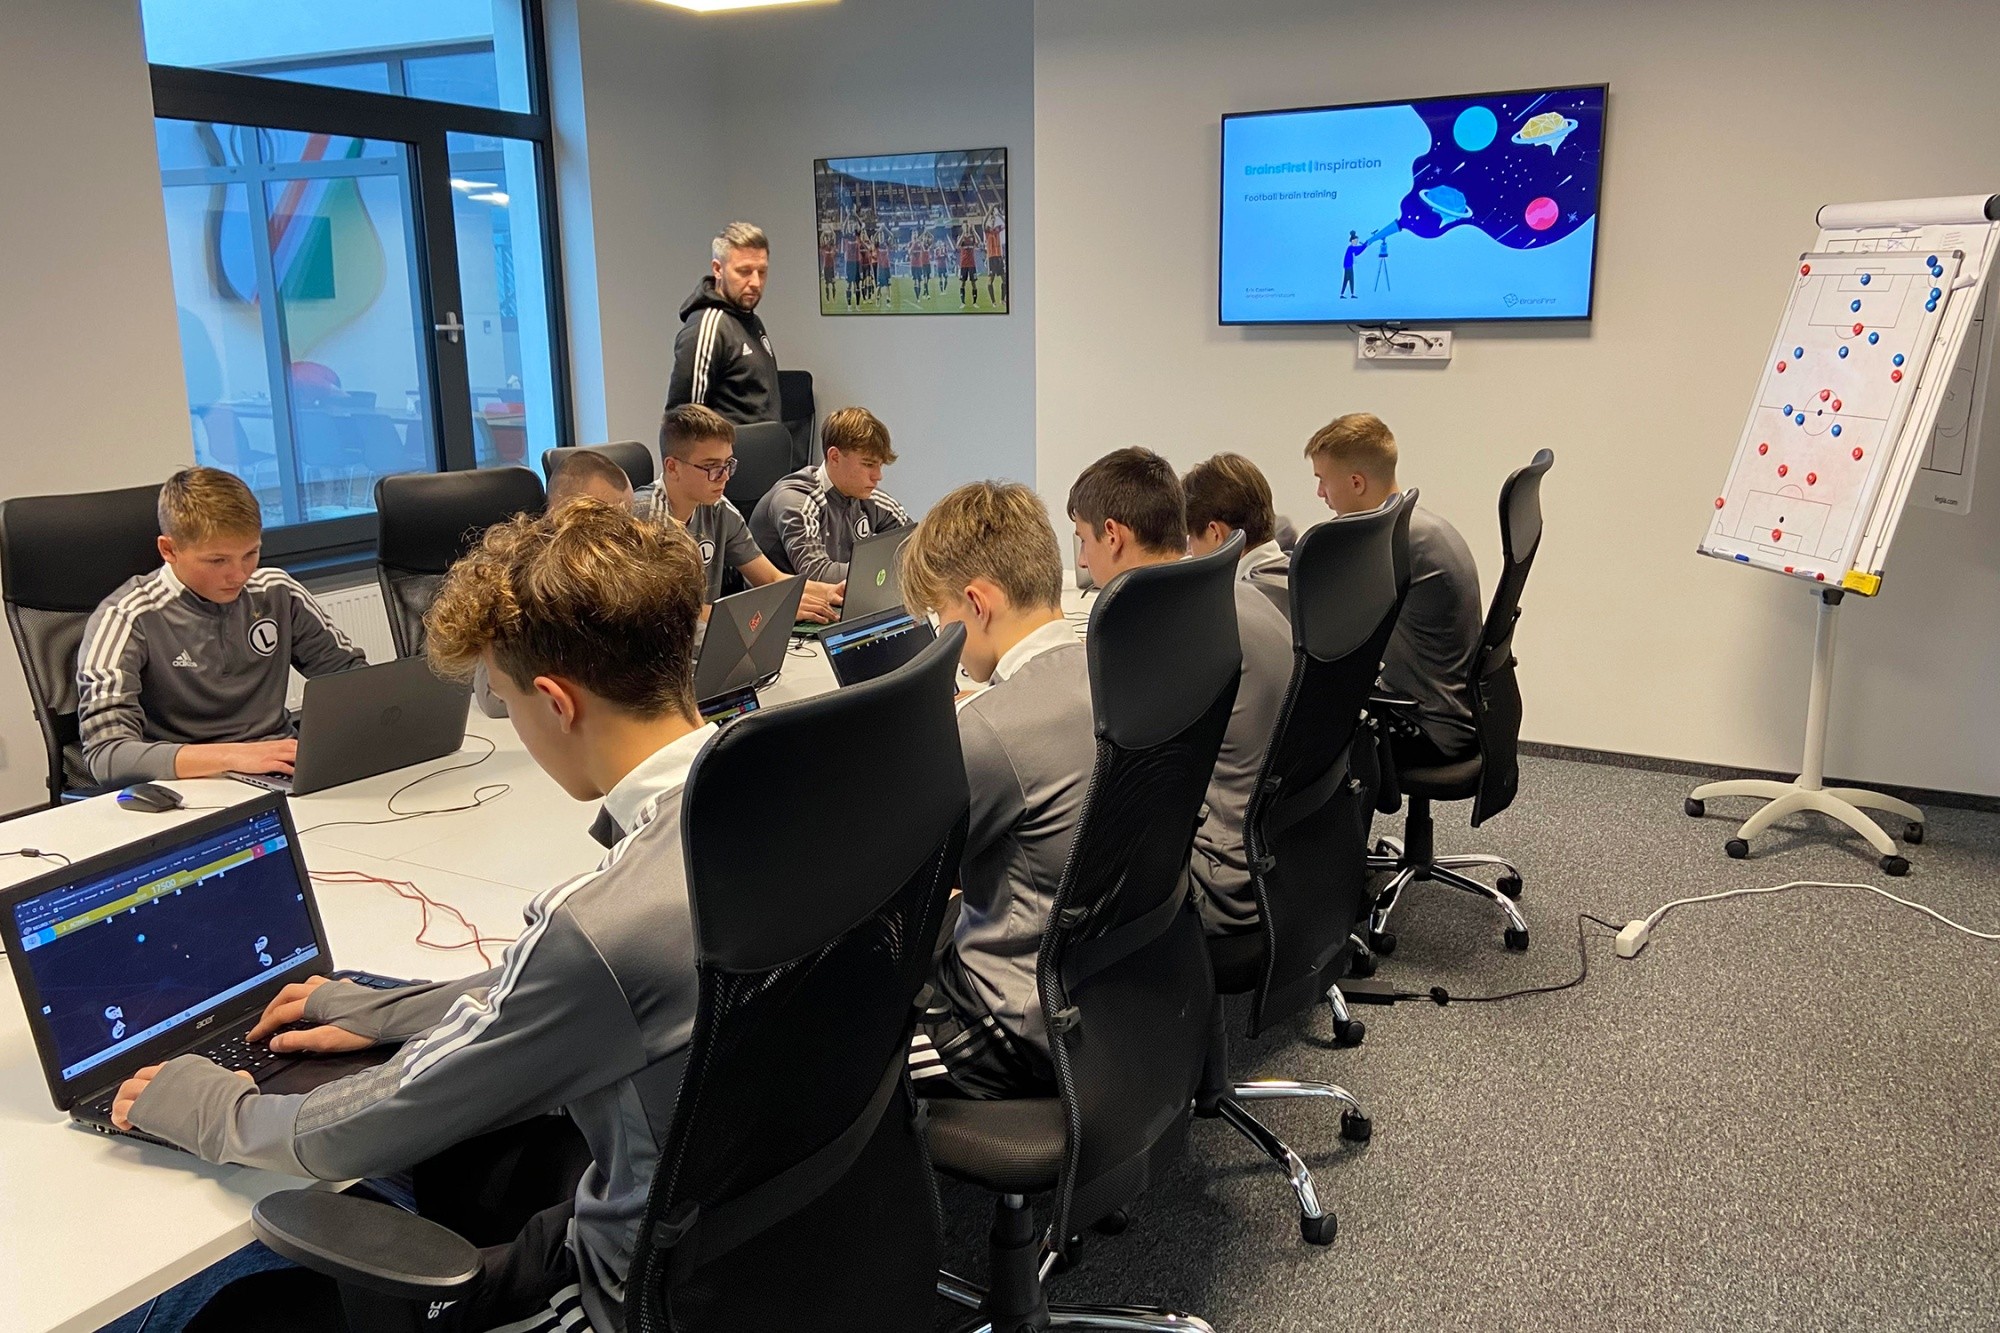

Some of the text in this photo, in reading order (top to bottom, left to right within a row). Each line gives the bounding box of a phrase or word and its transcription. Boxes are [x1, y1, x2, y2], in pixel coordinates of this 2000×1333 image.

[1244, 157, 1382, 176] BrainsFirst Inspiration
[1244, 189, 1338, 202] Football brain training
[151, 879, 177, 894] 17500
[195, 1014, 216, 1030] acer
